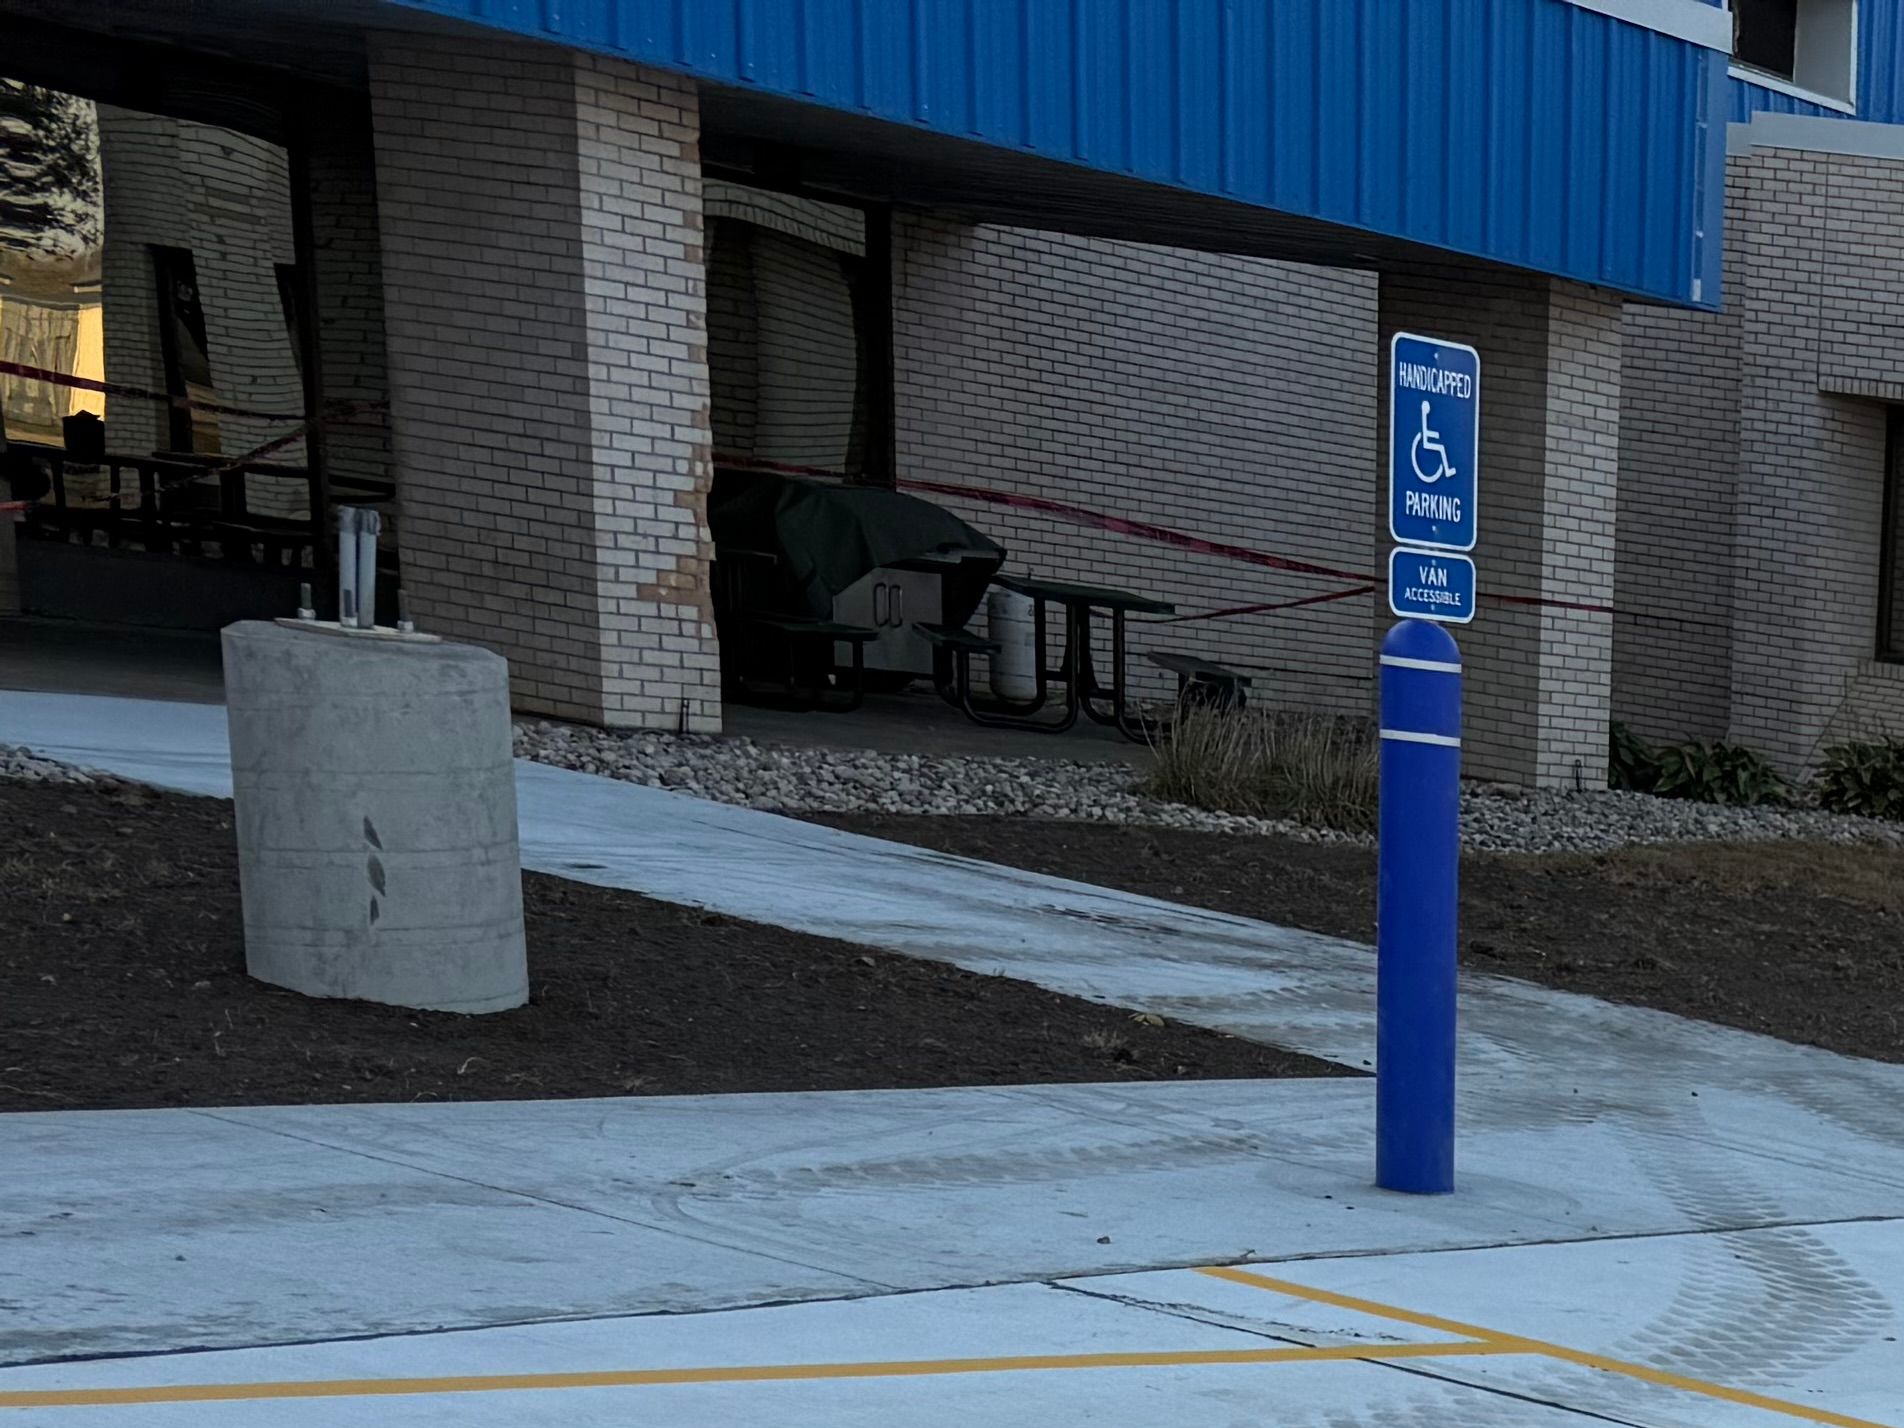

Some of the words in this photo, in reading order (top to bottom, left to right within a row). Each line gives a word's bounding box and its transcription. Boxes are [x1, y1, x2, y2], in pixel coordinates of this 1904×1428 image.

[1399, 361, 1471, 399] HANDICAPPED
[1406, 490, 1461, 522] PARKING
[1419, 566, 1447, 587] VAN
[1405, 587, 1462, 606] ACCESSIBLE
